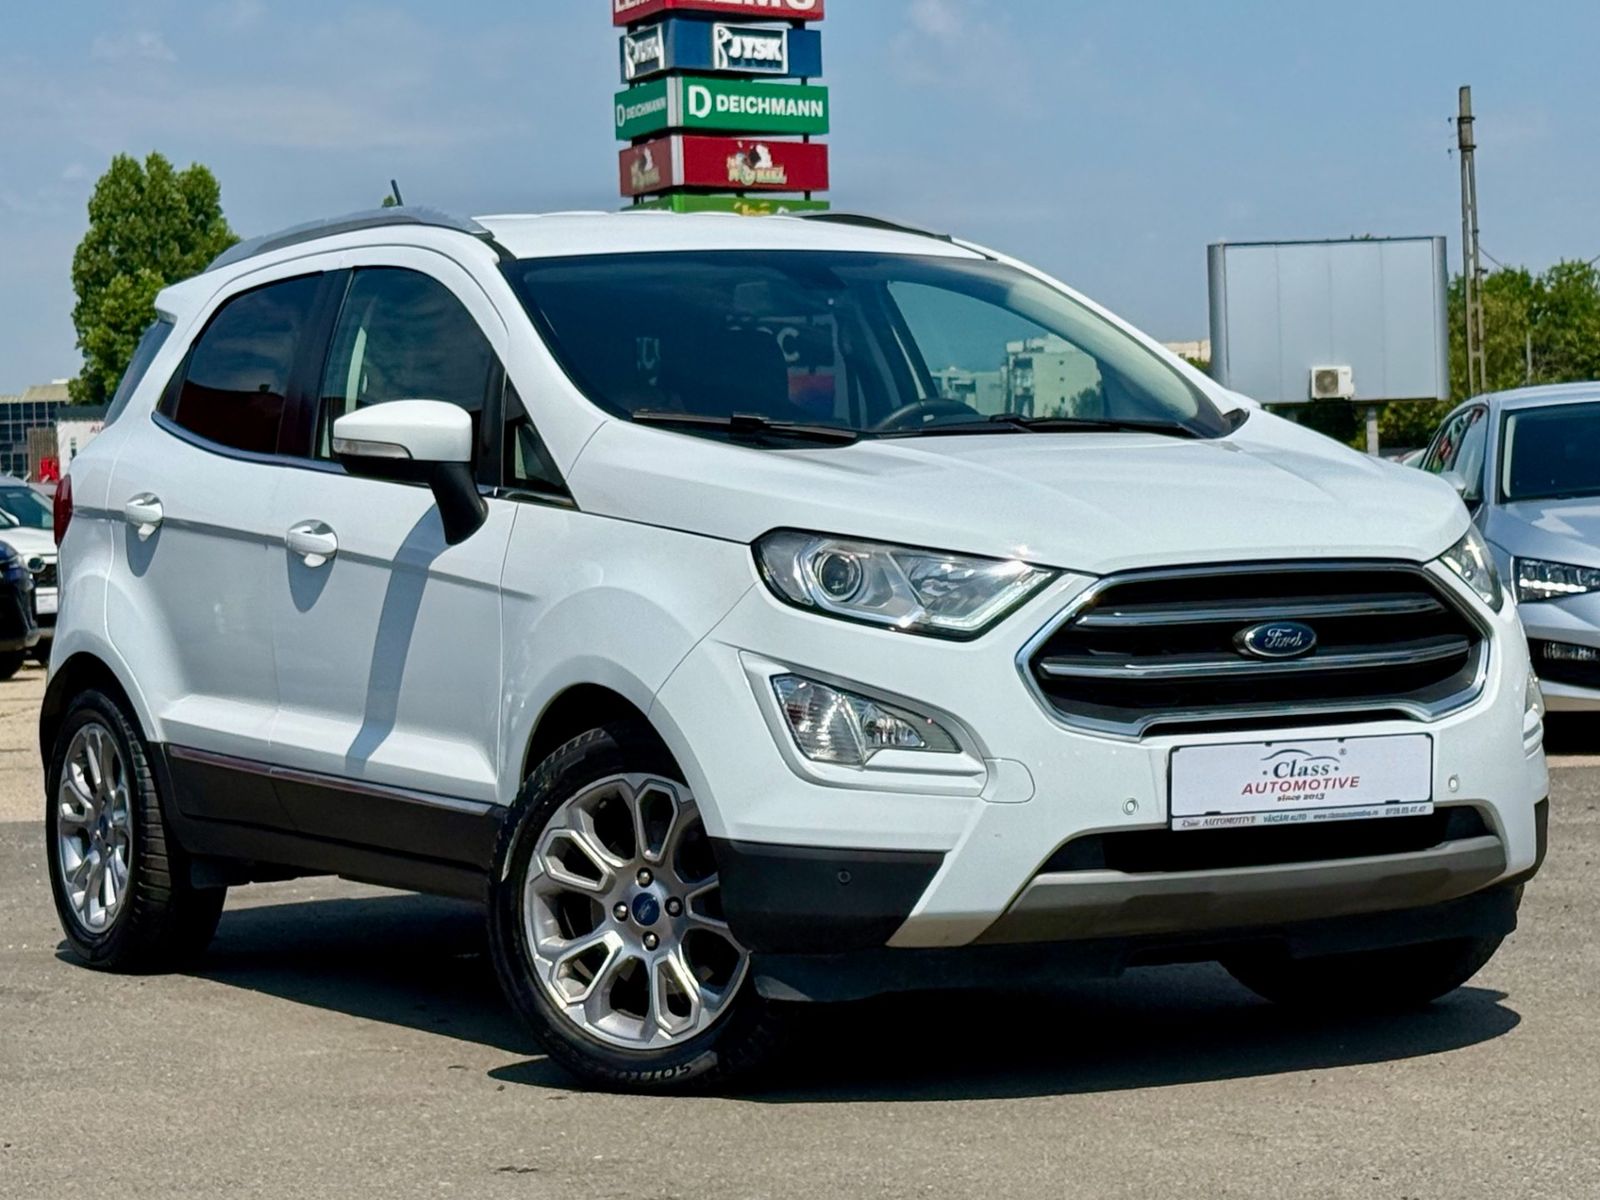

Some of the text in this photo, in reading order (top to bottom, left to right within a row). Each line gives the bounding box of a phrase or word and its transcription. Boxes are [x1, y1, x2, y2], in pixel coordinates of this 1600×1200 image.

[729, 35, 783, 61] JYSK
[688, 85, 823, 118] D DEICHMANN
[617, 104, 625, 127] D
[1264, 628, 1302, 648] Ford
[1273, 759, 1330, 779] Class
[1241, 776, 1360, 795] AUTOMOTIVE
[1203, 816, 1256, 827] AUTOMOTIVE
